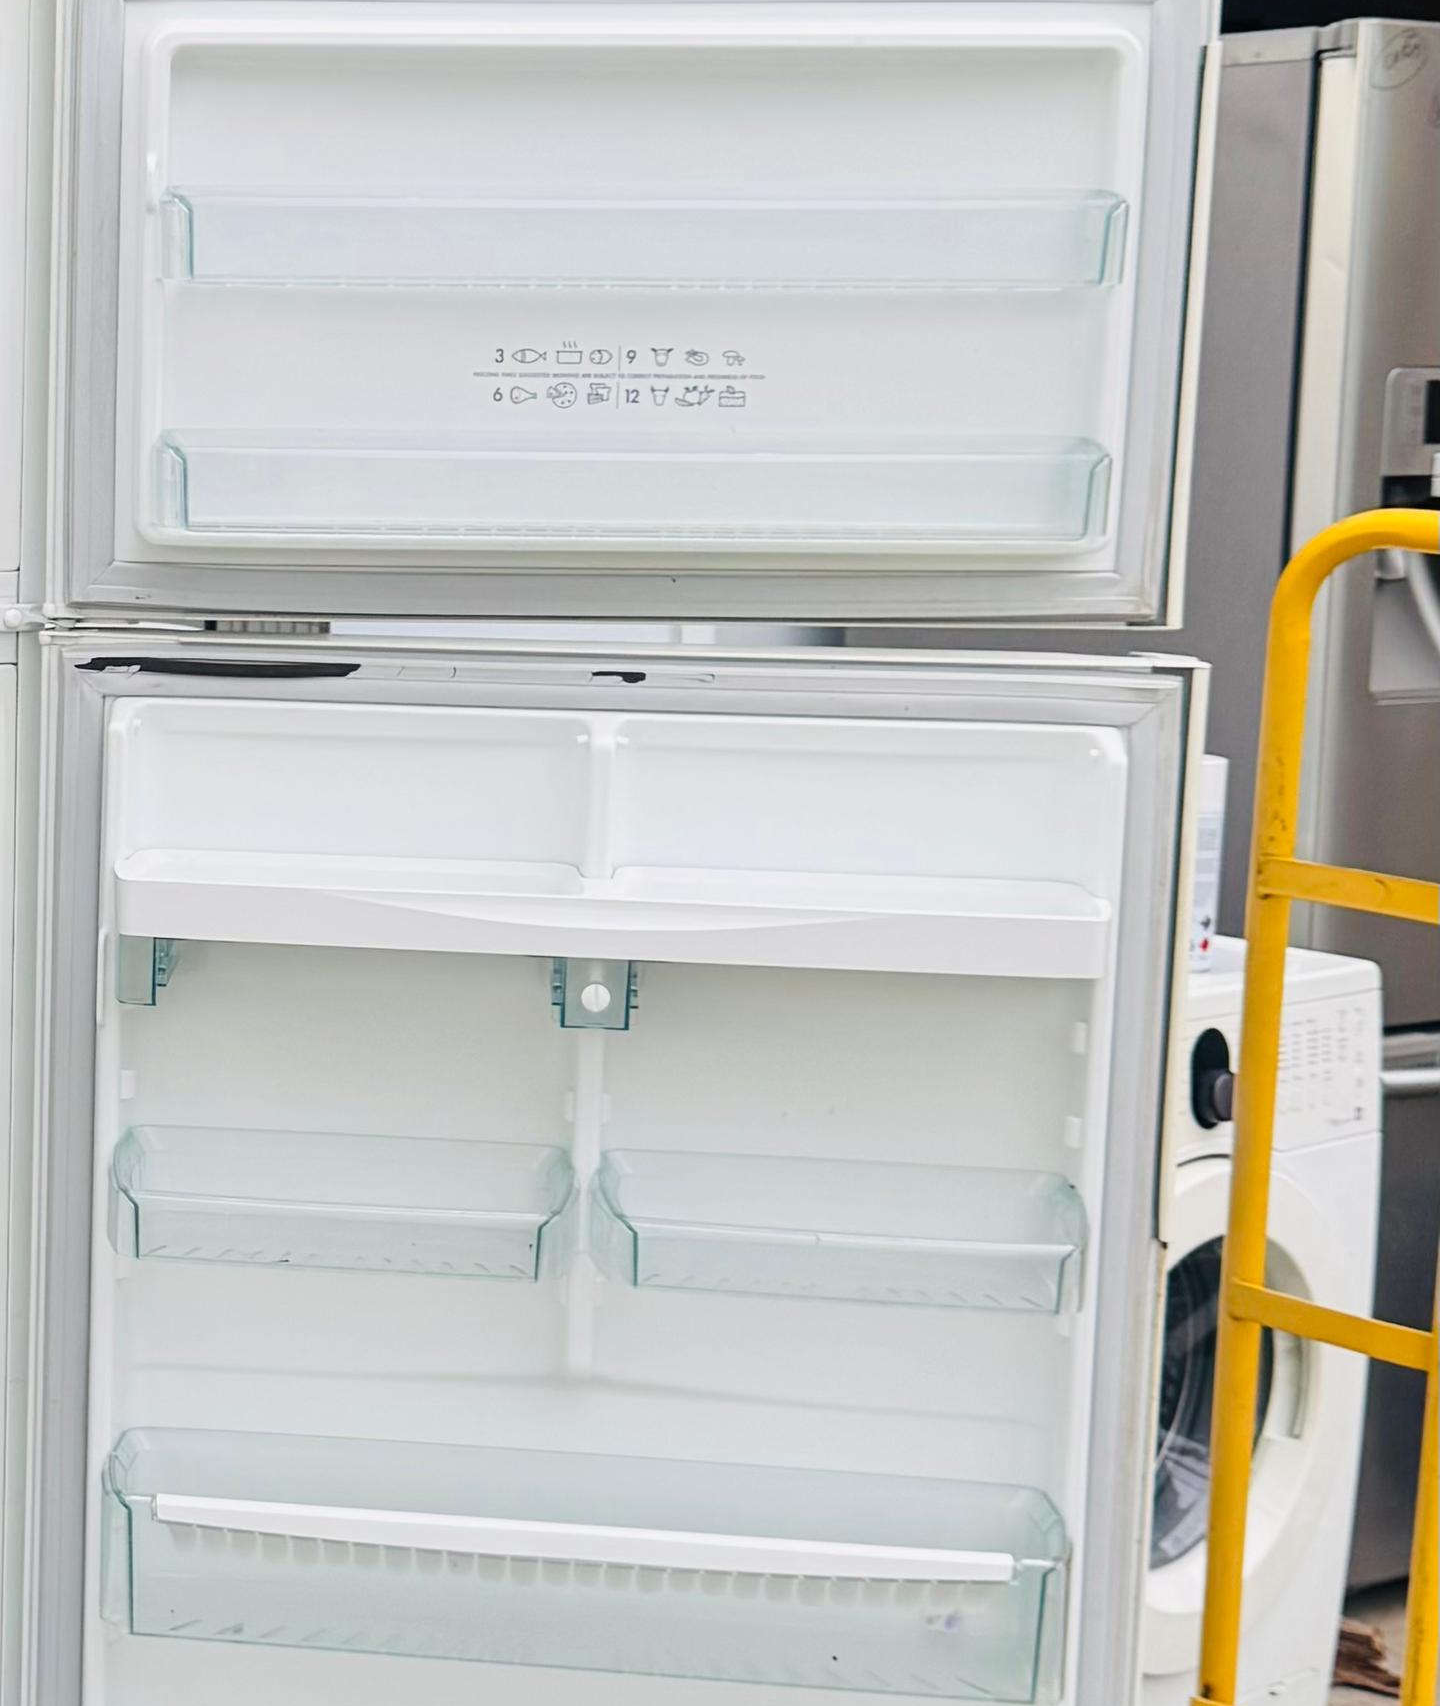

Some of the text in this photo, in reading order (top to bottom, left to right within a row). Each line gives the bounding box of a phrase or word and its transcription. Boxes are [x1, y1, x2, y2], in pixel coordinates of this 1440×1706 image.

[494, 348, 505, 364] 3
[626, 349, 637, 364] 9
[492, 387, 503, 402] 6
[624, 388, 640, 404] 12
